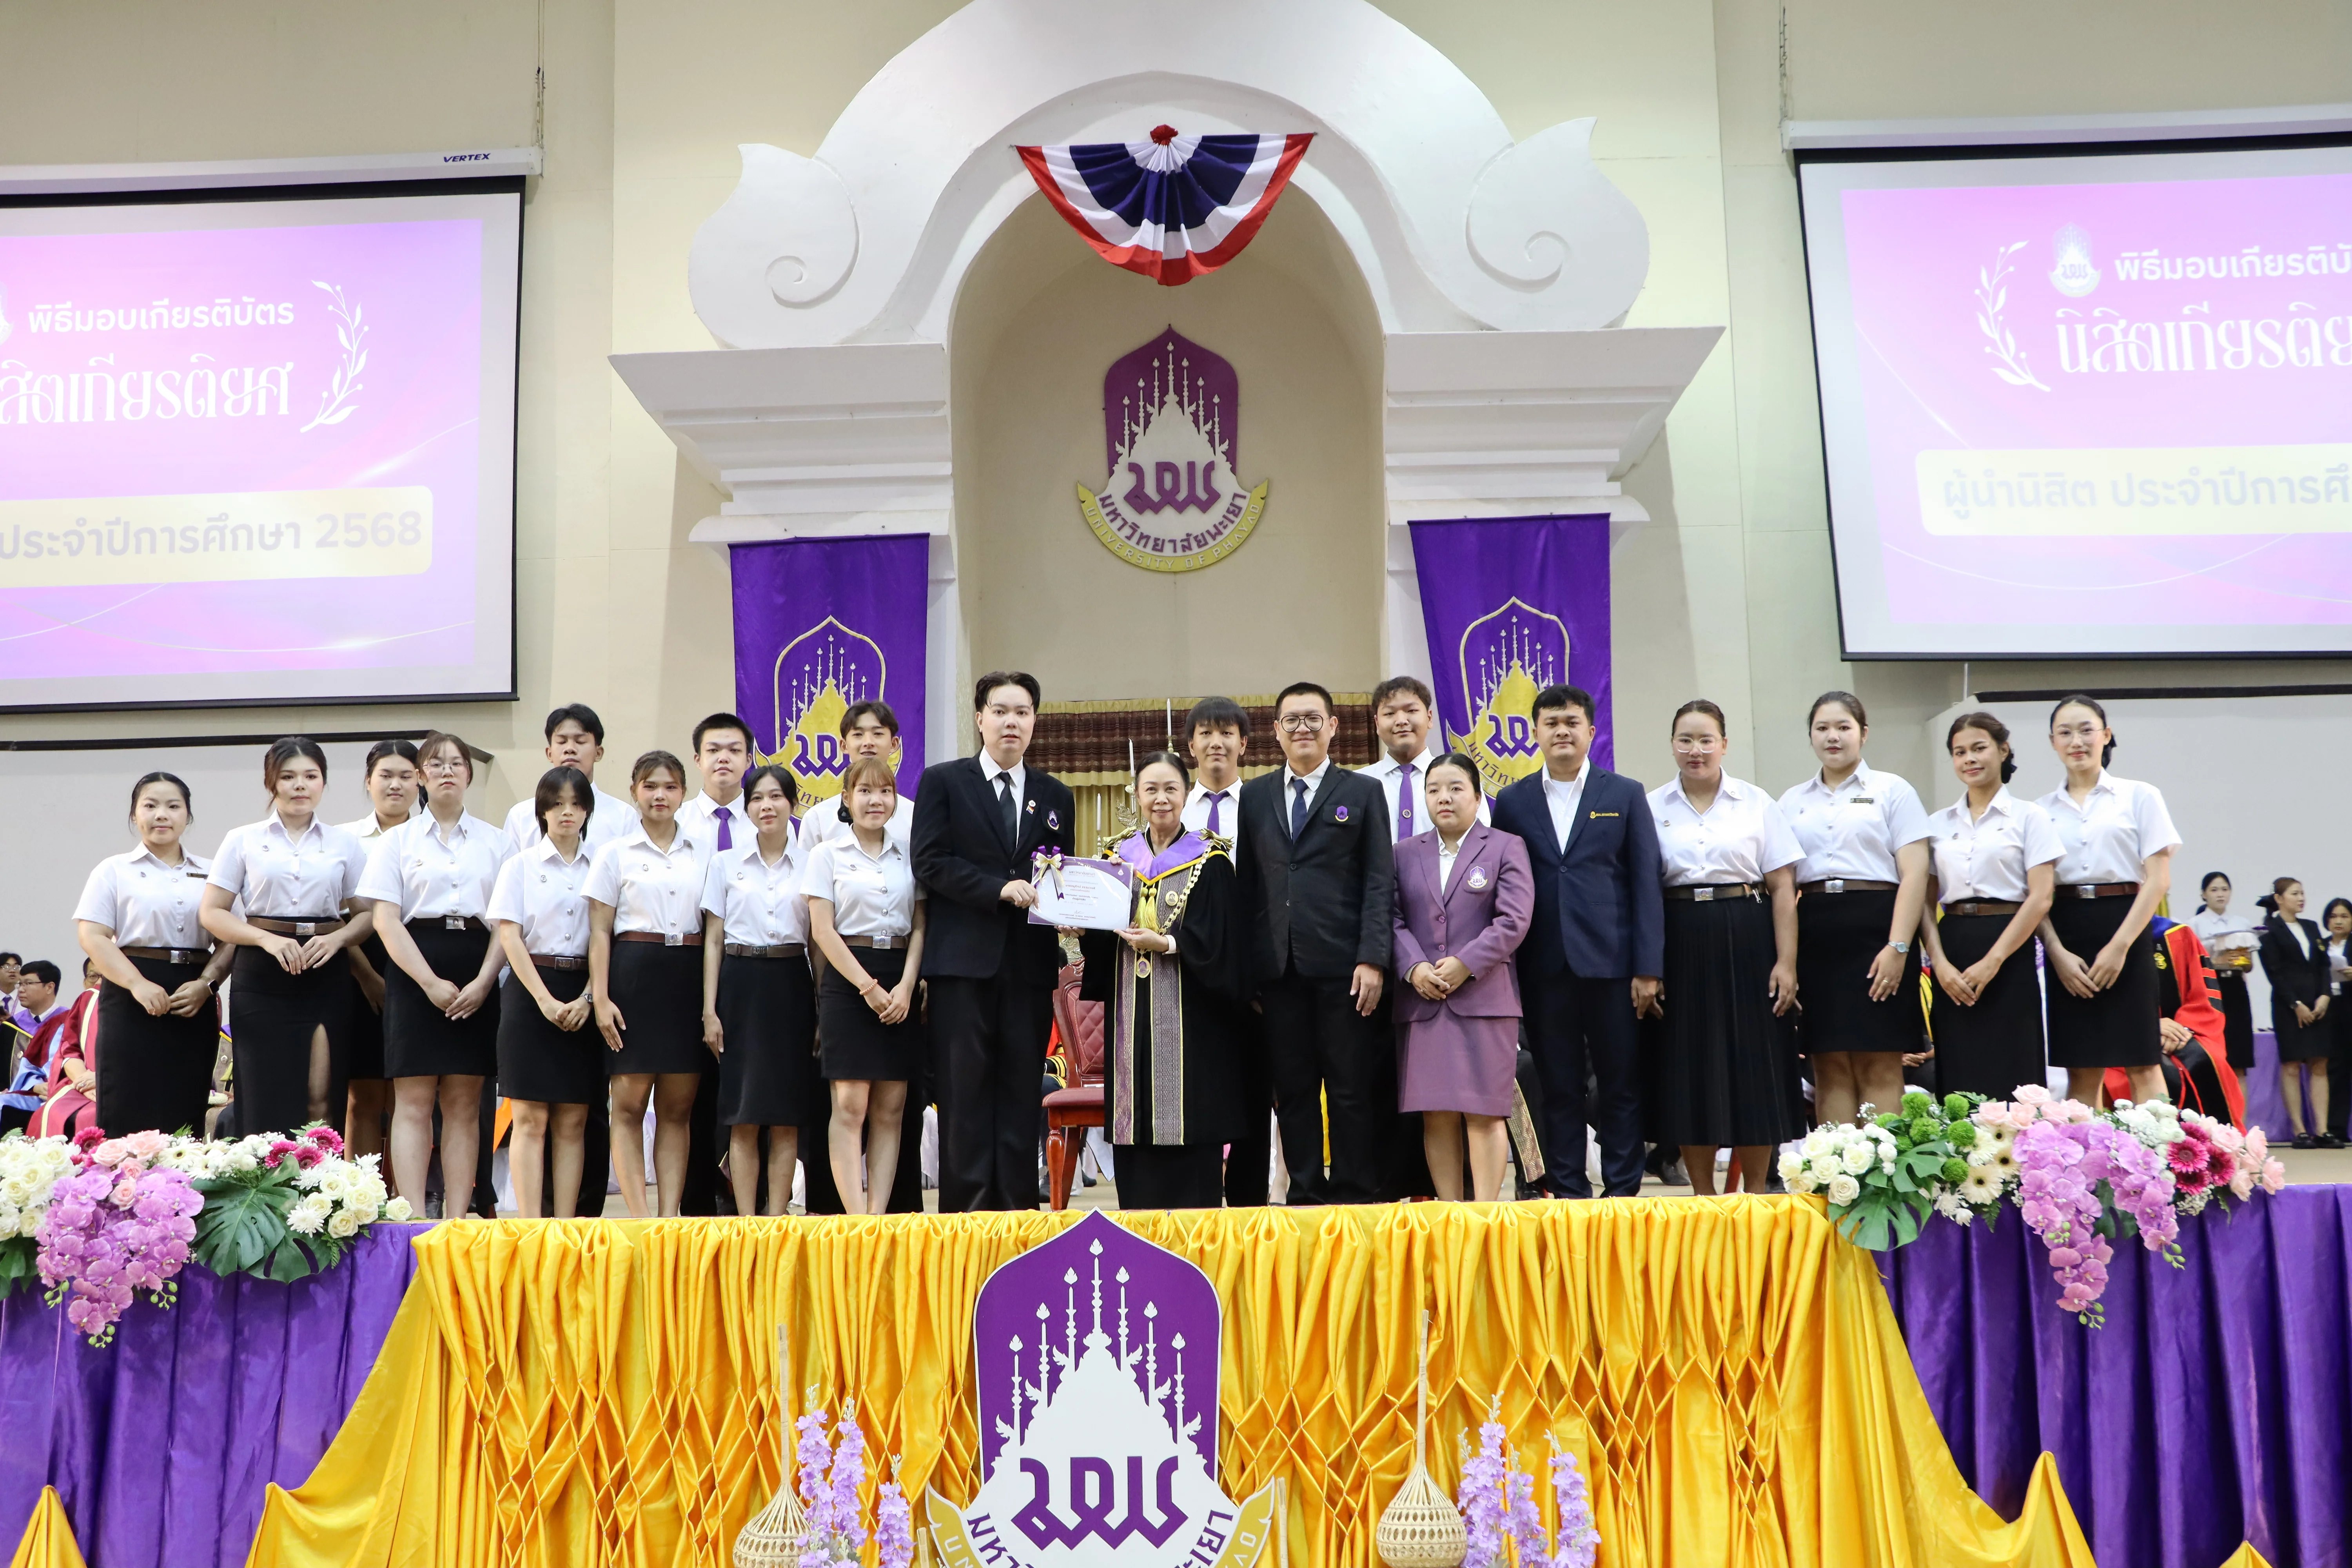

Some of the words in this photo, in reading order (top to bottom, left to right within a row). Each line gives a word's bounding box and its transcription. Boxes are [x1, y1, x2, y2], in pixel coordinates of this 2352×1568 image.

[443, 153, 491, 163] VERTEX
[28, 296, 294, 333] พิธีมอบเกียรติบัตร
[1944, 468, 2096, 519] ผู้นำนิสิต
[0, 512, 301, 560] ประจำปีการศึกษา
[316, 510, 422, 549] 2568
[1087, 507, 1174, 569] UNIVERSITY
[1185, 555, 1205, 568] OF
[1212, 504, 1260, 558] PHAYAO
[1099, 493, 1247, 554] มหาวิทยาลัยพะเยา
